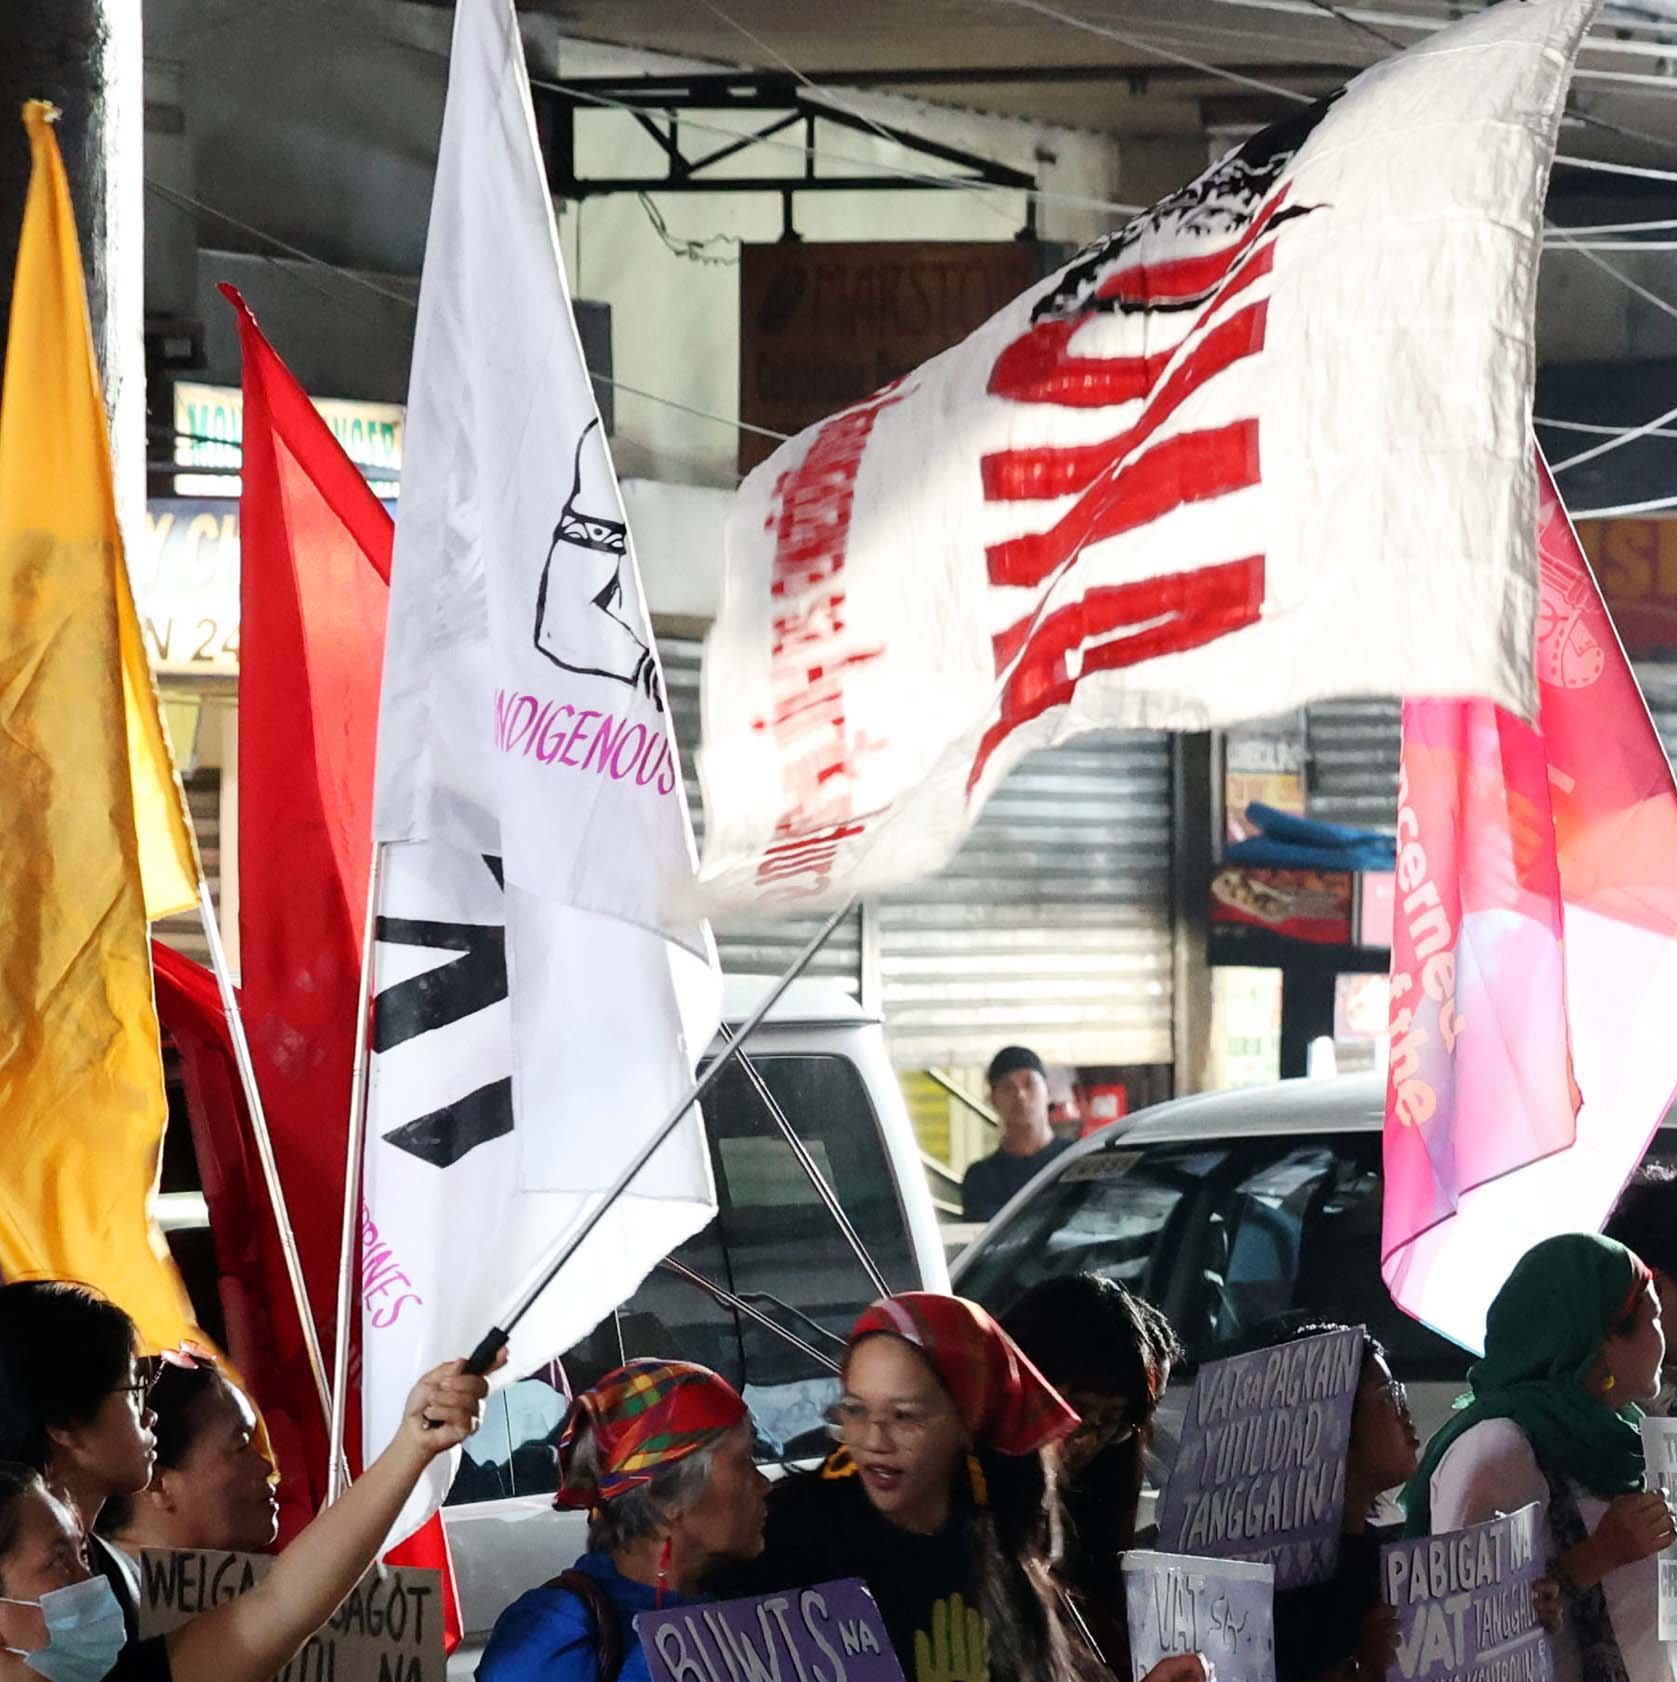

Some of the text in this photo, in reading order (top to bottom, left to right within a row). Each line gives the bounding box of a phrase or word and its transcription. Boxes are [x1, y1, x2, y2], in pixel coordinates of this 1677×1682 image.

[494, 687, 677, 796] NDIGENOUS
[1385, 1524, 1504, 1607] PABIGAT
[1509, 1515, 1533, 1572] NA
[838, 1618, 880, 1657] NA
[1396, 1591, 1473, 1680] VAT
